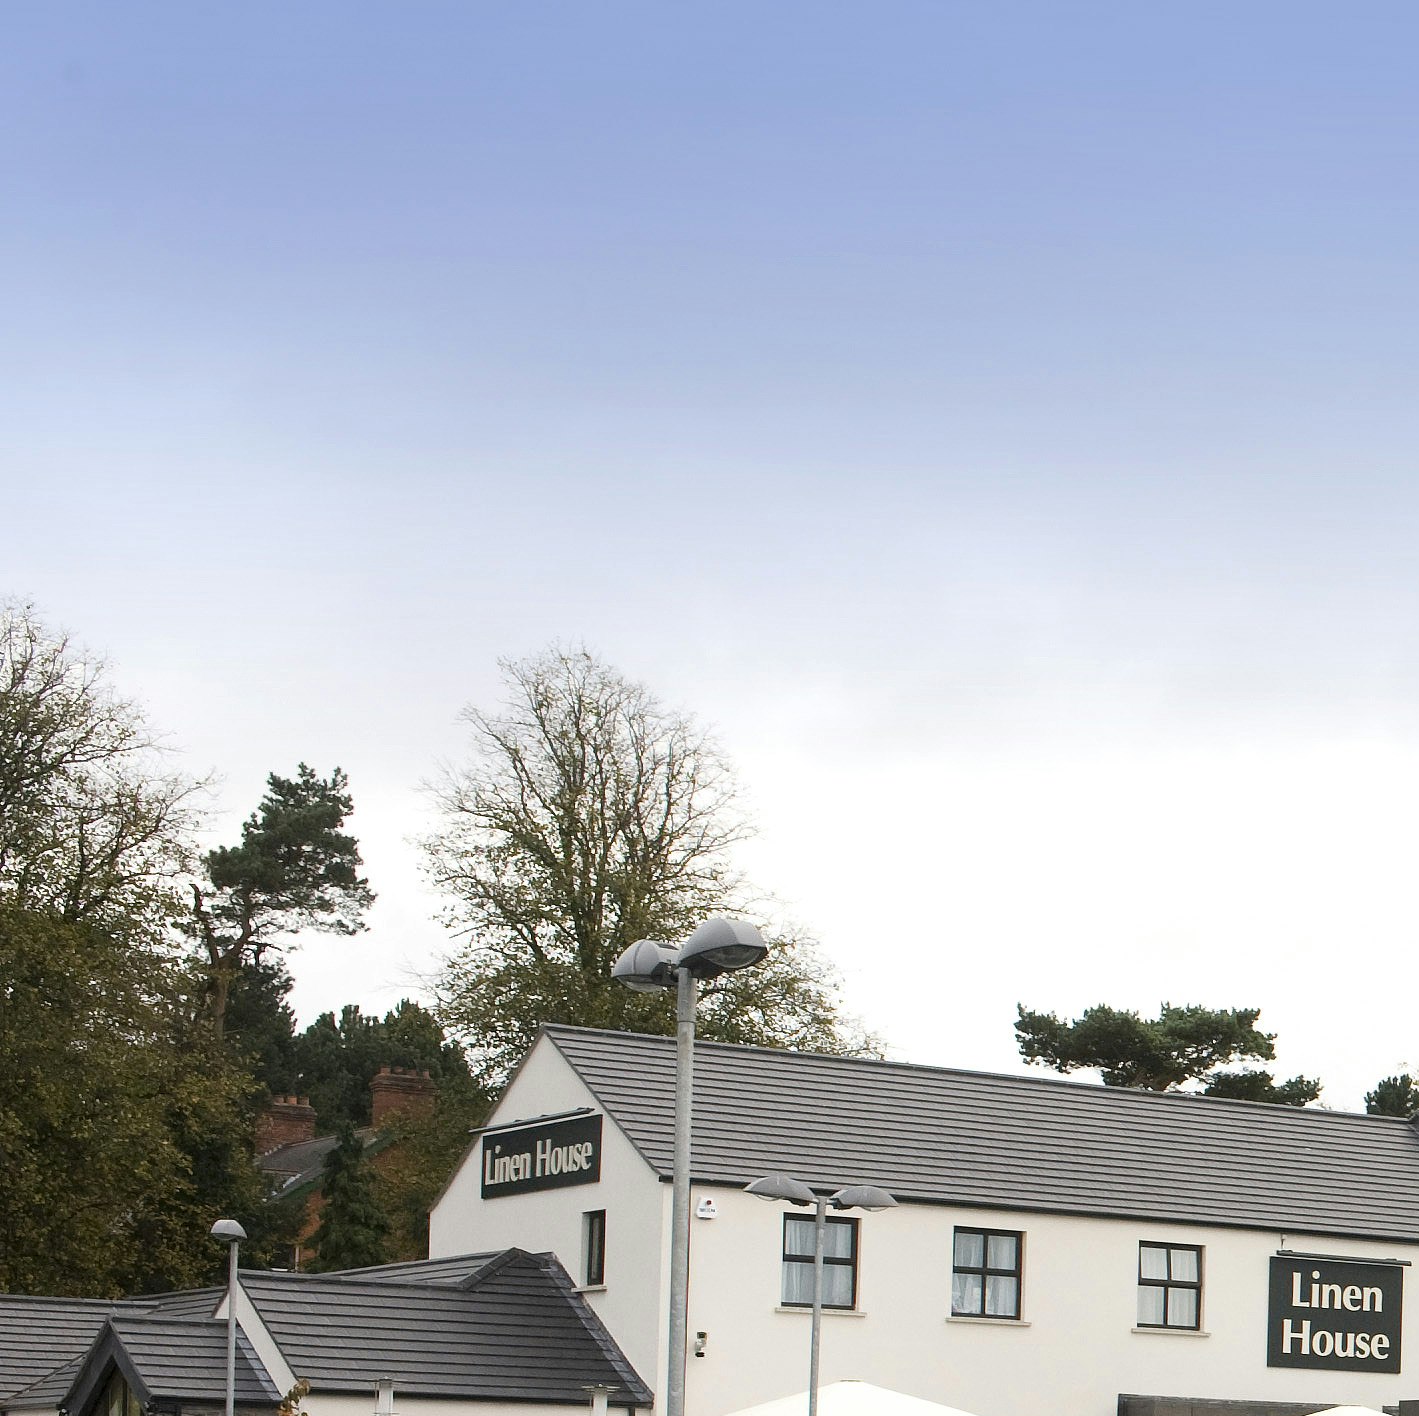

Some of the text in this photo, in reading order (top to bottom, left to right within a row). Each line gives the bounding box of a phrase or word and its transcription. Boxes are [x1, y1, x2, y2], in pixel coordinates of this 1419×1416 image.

[484, 1139, 592, 1185] Linen House
[1291, 1270, 1383, 1312] Linen
[1282, 1318, 1390, 1360] House
